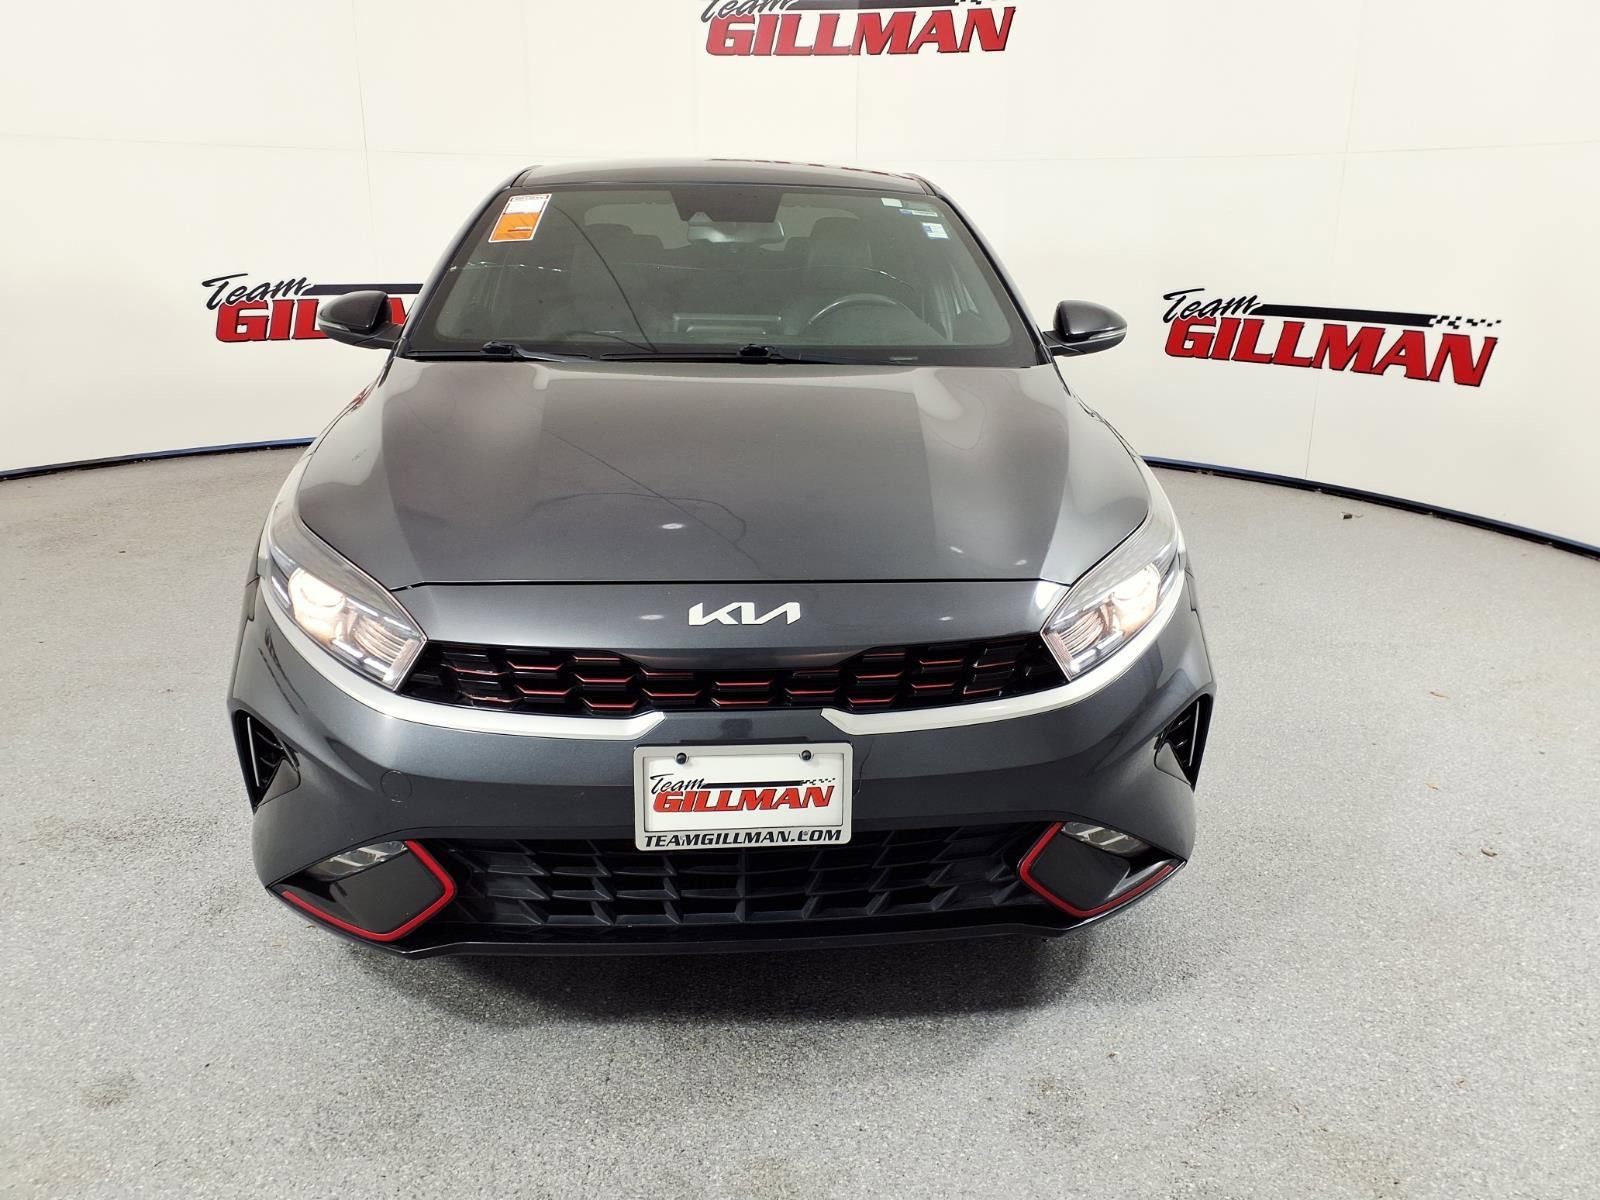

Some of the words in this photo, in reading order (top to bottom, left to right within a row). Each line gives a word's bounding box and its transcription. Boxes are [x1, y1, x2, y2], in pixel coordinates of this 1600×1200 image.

[705, 6, 1016, 56] GILLMAN
[201, 273, 312, 310] Team
[1163, 288, 1260, 323] Team
[1164, 315, 1499, 388] GILLMAN
[650, 773, 704, 794] Team
[653, 785, 835, 812] GILLMAN
[644, 829, 842, 848] TEAMGILLMAN.COM
